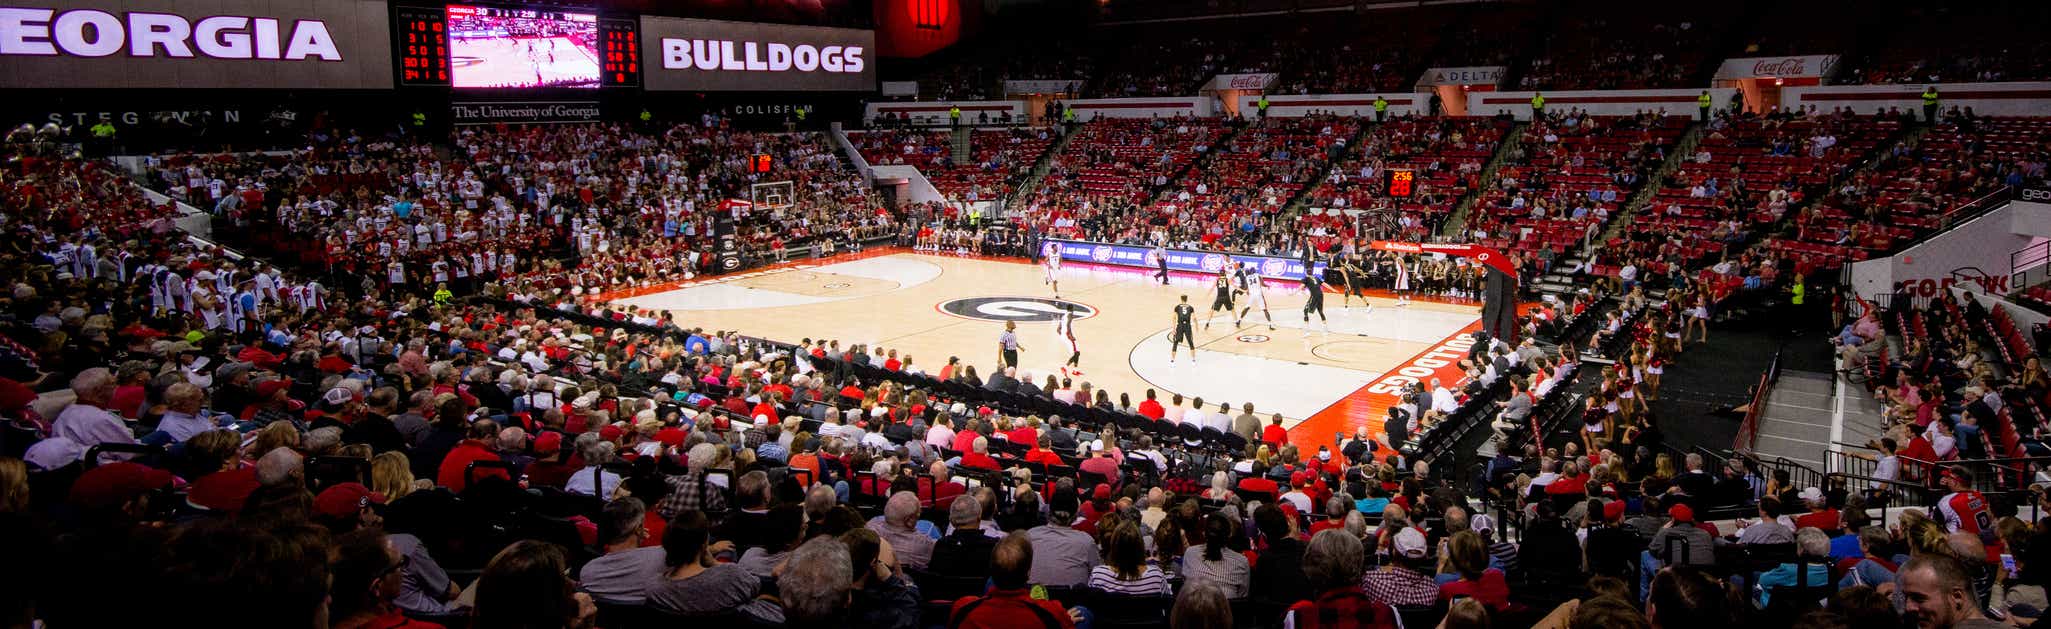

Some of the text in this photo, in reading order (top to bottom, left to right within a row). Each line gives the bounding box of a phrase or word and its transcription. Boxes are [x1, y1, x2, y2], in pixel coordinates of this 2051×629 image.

[0, 8, 342, 60] EORGIA
[662, 38, 864, 73] BULLDOGS
[1752, 58, 1804, 76] Coca-Cola
[1450, 71, 1500, 80] DELTA
[455, 106, 600, 121] The University of Georgia
[1394, 172, 1412, 180] 2:56
[1390, 182, 1410, 196] 28
[1903, 278, 1936, 297] GO
[1182, 306, 1188, 316] 5
